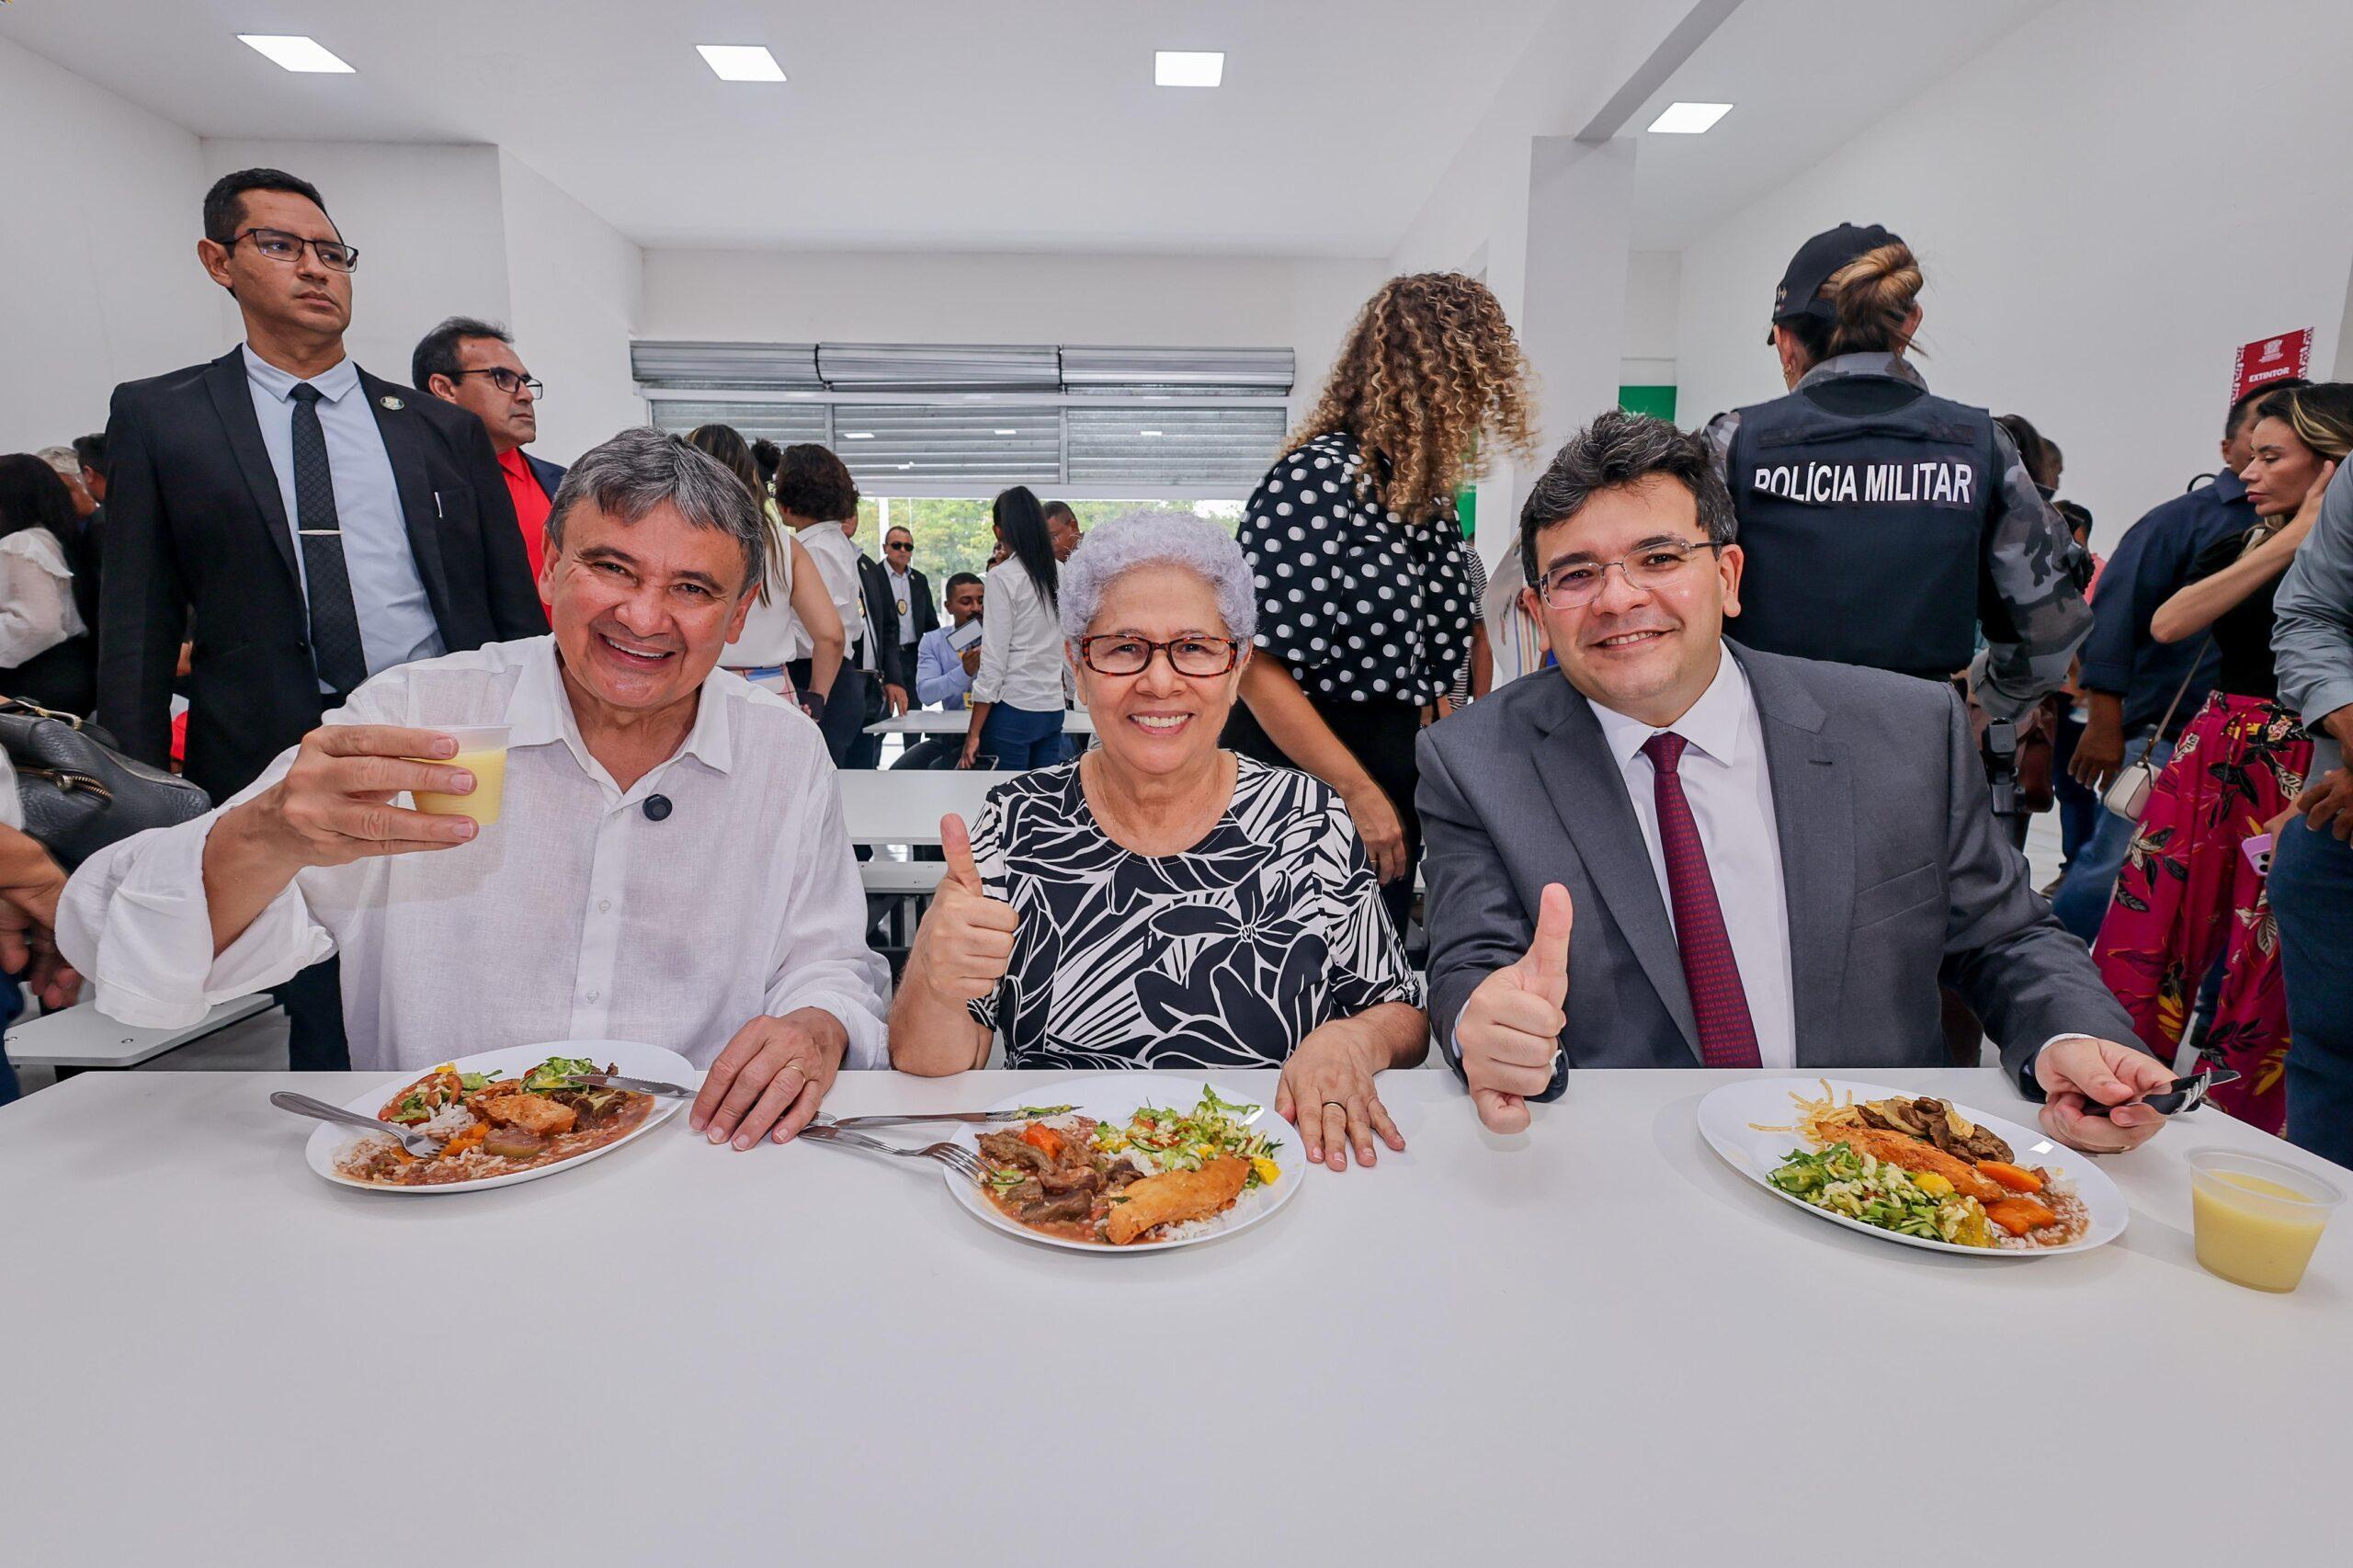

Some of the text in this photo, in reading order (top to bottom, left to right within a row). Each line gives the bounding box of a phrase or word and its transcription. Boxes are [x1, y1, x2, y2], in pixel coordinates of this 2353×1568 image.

[2248, 367, 2290, 382] EXTINTOR
[1755, 461, 1972, 503] POLÍCIA MILITAR
